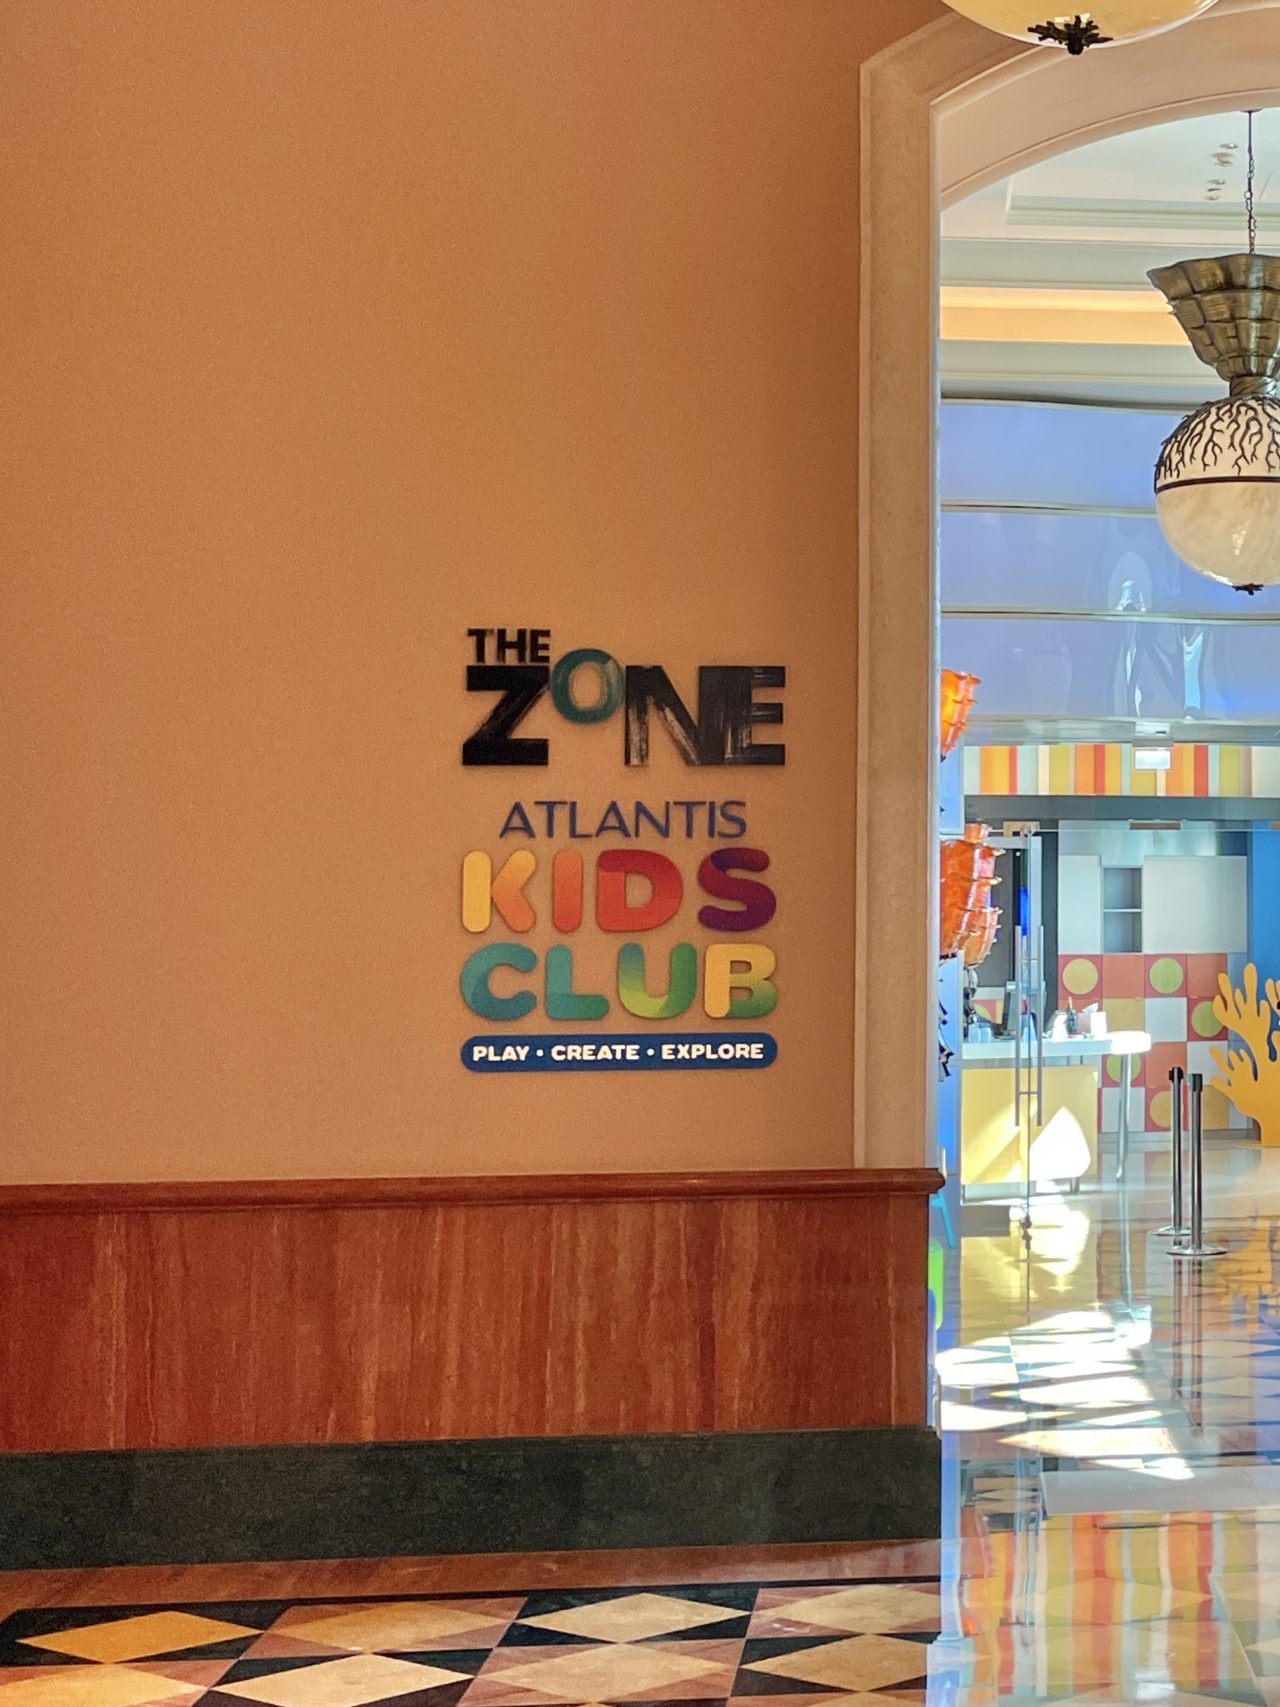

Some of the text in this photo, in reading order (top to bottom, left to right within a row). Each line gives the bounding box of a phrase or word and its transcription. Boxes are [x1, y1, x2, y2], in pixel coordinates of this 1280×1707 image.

[467, 628, 551, 663] THE
[462, 648, 786, 766] ZONE
[500, 800, 747, 838] ATLANTIS
[462, 846, 777, 933] KIDS
[460, 942, 779, 1020] CLUB
[472, 1043, 764, 1061] PLAY CREATE EXPLORE
